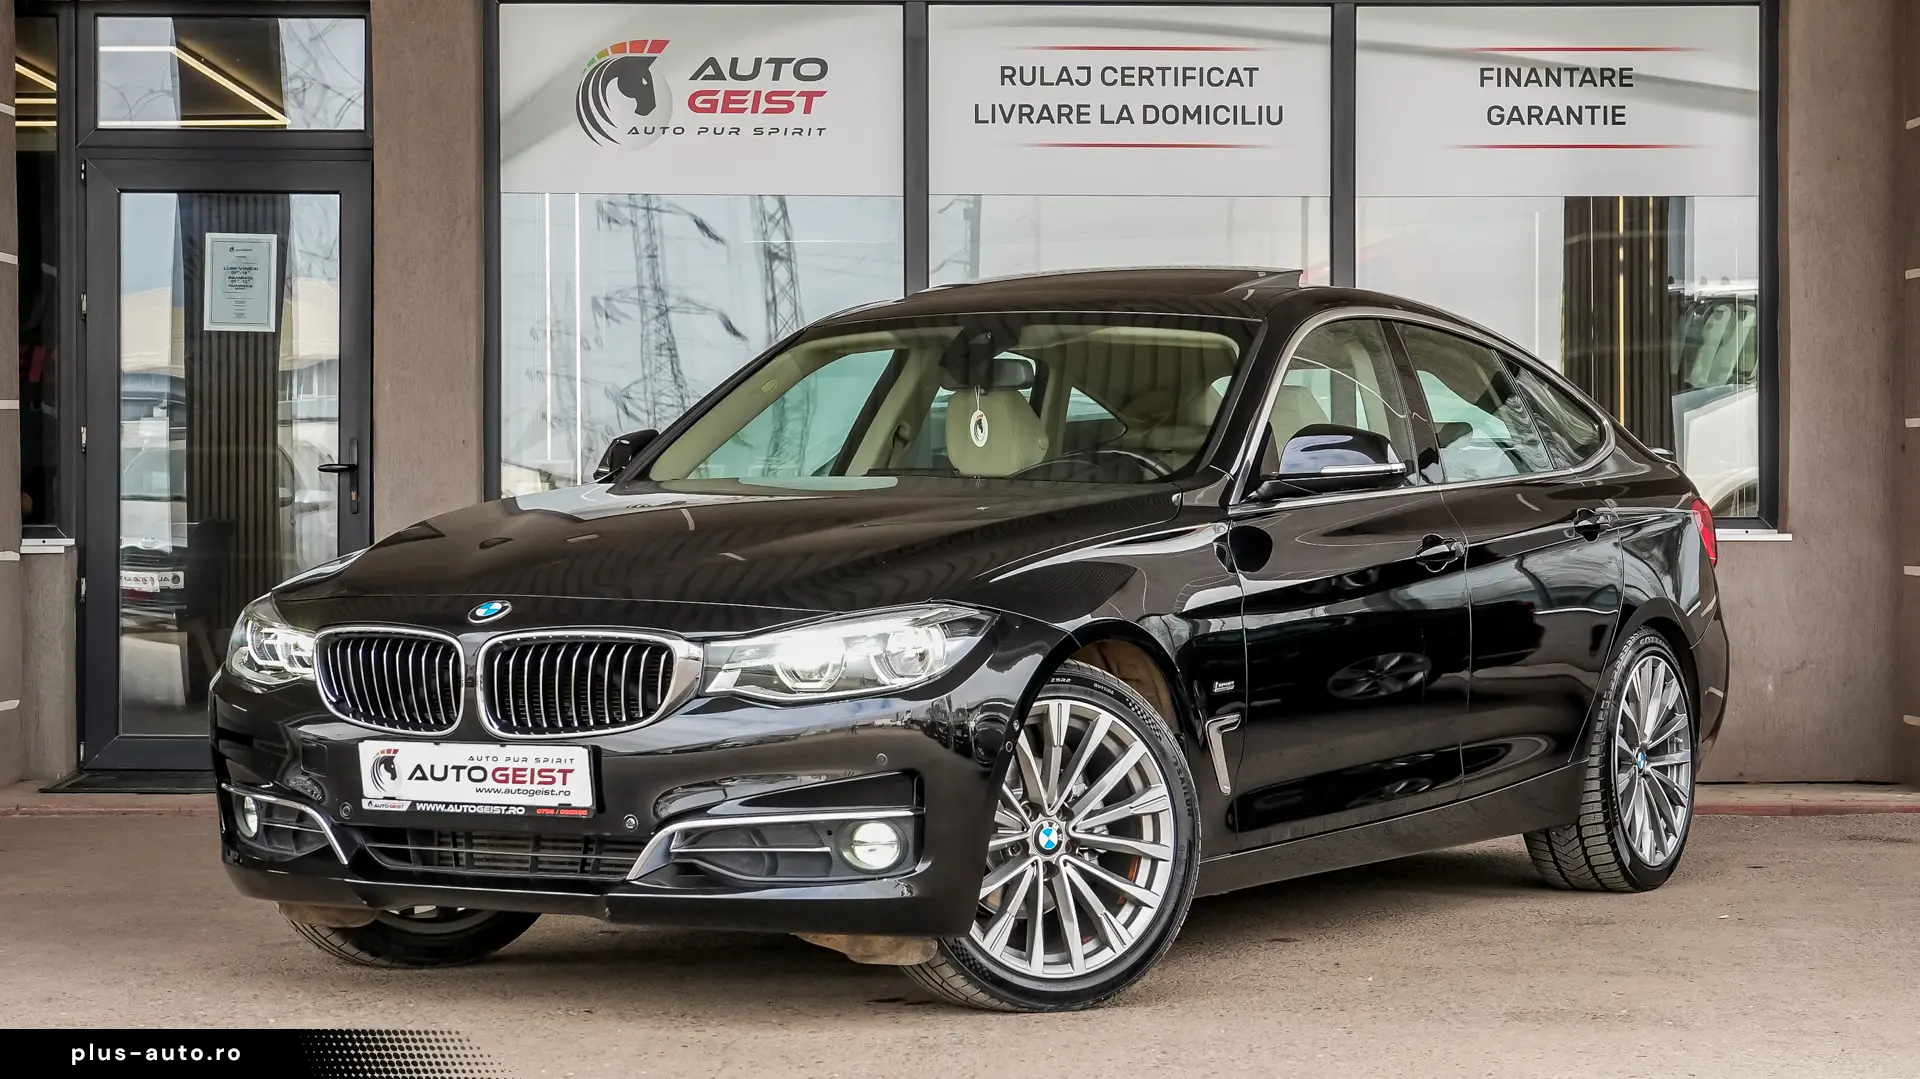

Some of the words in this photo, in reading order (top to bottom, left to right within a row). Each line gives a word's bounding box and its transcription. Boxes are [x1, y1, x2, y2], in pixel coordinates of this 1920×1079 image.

[688, 56, 829, 82] AUTO
[1000, 65, 1092, 87] RULAJ
[1100, 66, 1260, 88] CERTIFICAT
[1479, 66, 1634, 88] FINANTARE
[687, 89, 828, 115] GEIST
[974, 103, 1092, 125] LIVRARE
[1100, 104, 1136, 125] LA
[1142, 104, 1283, 126] DOMICILIU
[1486, 105, 1627, 126] GARANTIE
[626, 126, 686, 136] AUTO
[697, 126, 741, 136] PUR
[752, 127, 827, 137] SPIRIT
[475, 787, 571, 798] www.autogeist.ro
[416, 802, 526, 815] WWW.AUTOGEIST.RO
